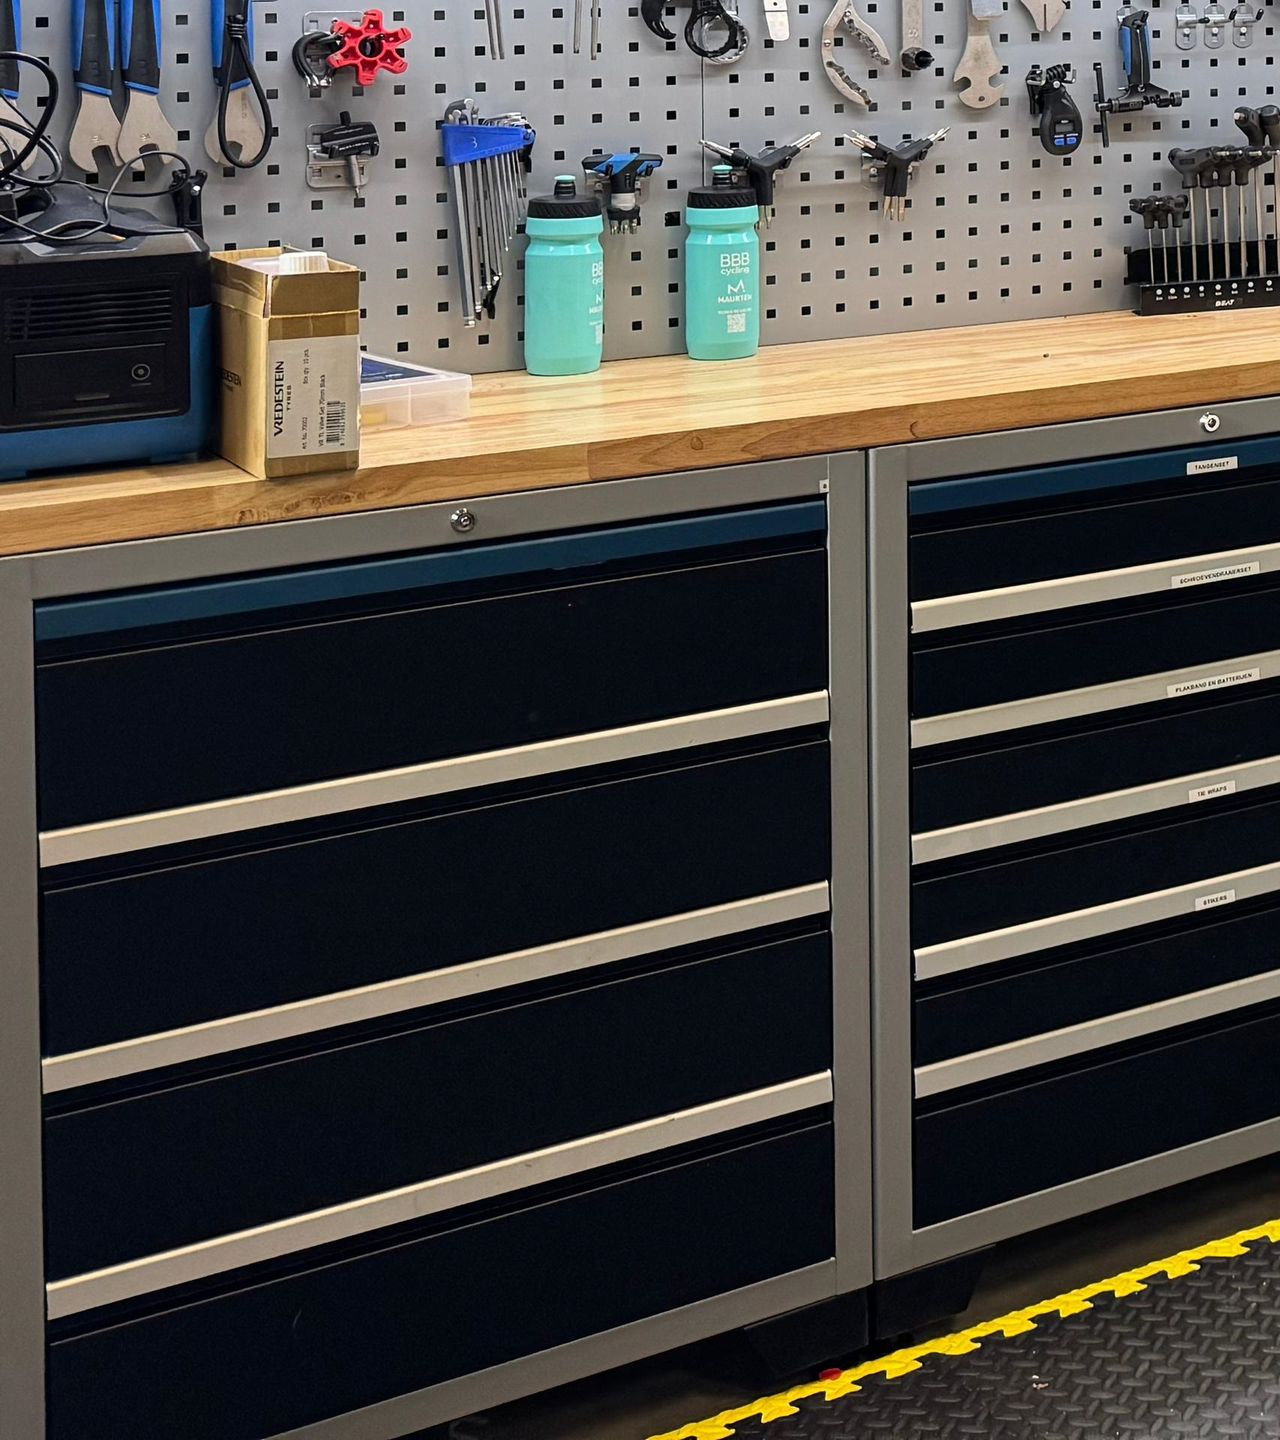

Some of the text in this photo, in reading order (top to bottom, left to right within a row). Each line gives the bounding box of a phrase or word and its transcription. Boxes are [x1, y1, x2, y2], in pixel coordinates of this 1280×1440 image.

[720, 252, 750, 268] BBB
[720, 266, 750, 276] cycling
[718, 294, 752, 304] MAURTEN
[273, 361, 284, 437] VREDESTEIN
[1194, 461, 1230, 471] TANGENSET
[1175, 682, 1207, 693] PLAKBAND
[1207, 786, 1227, 795] WRAPS
